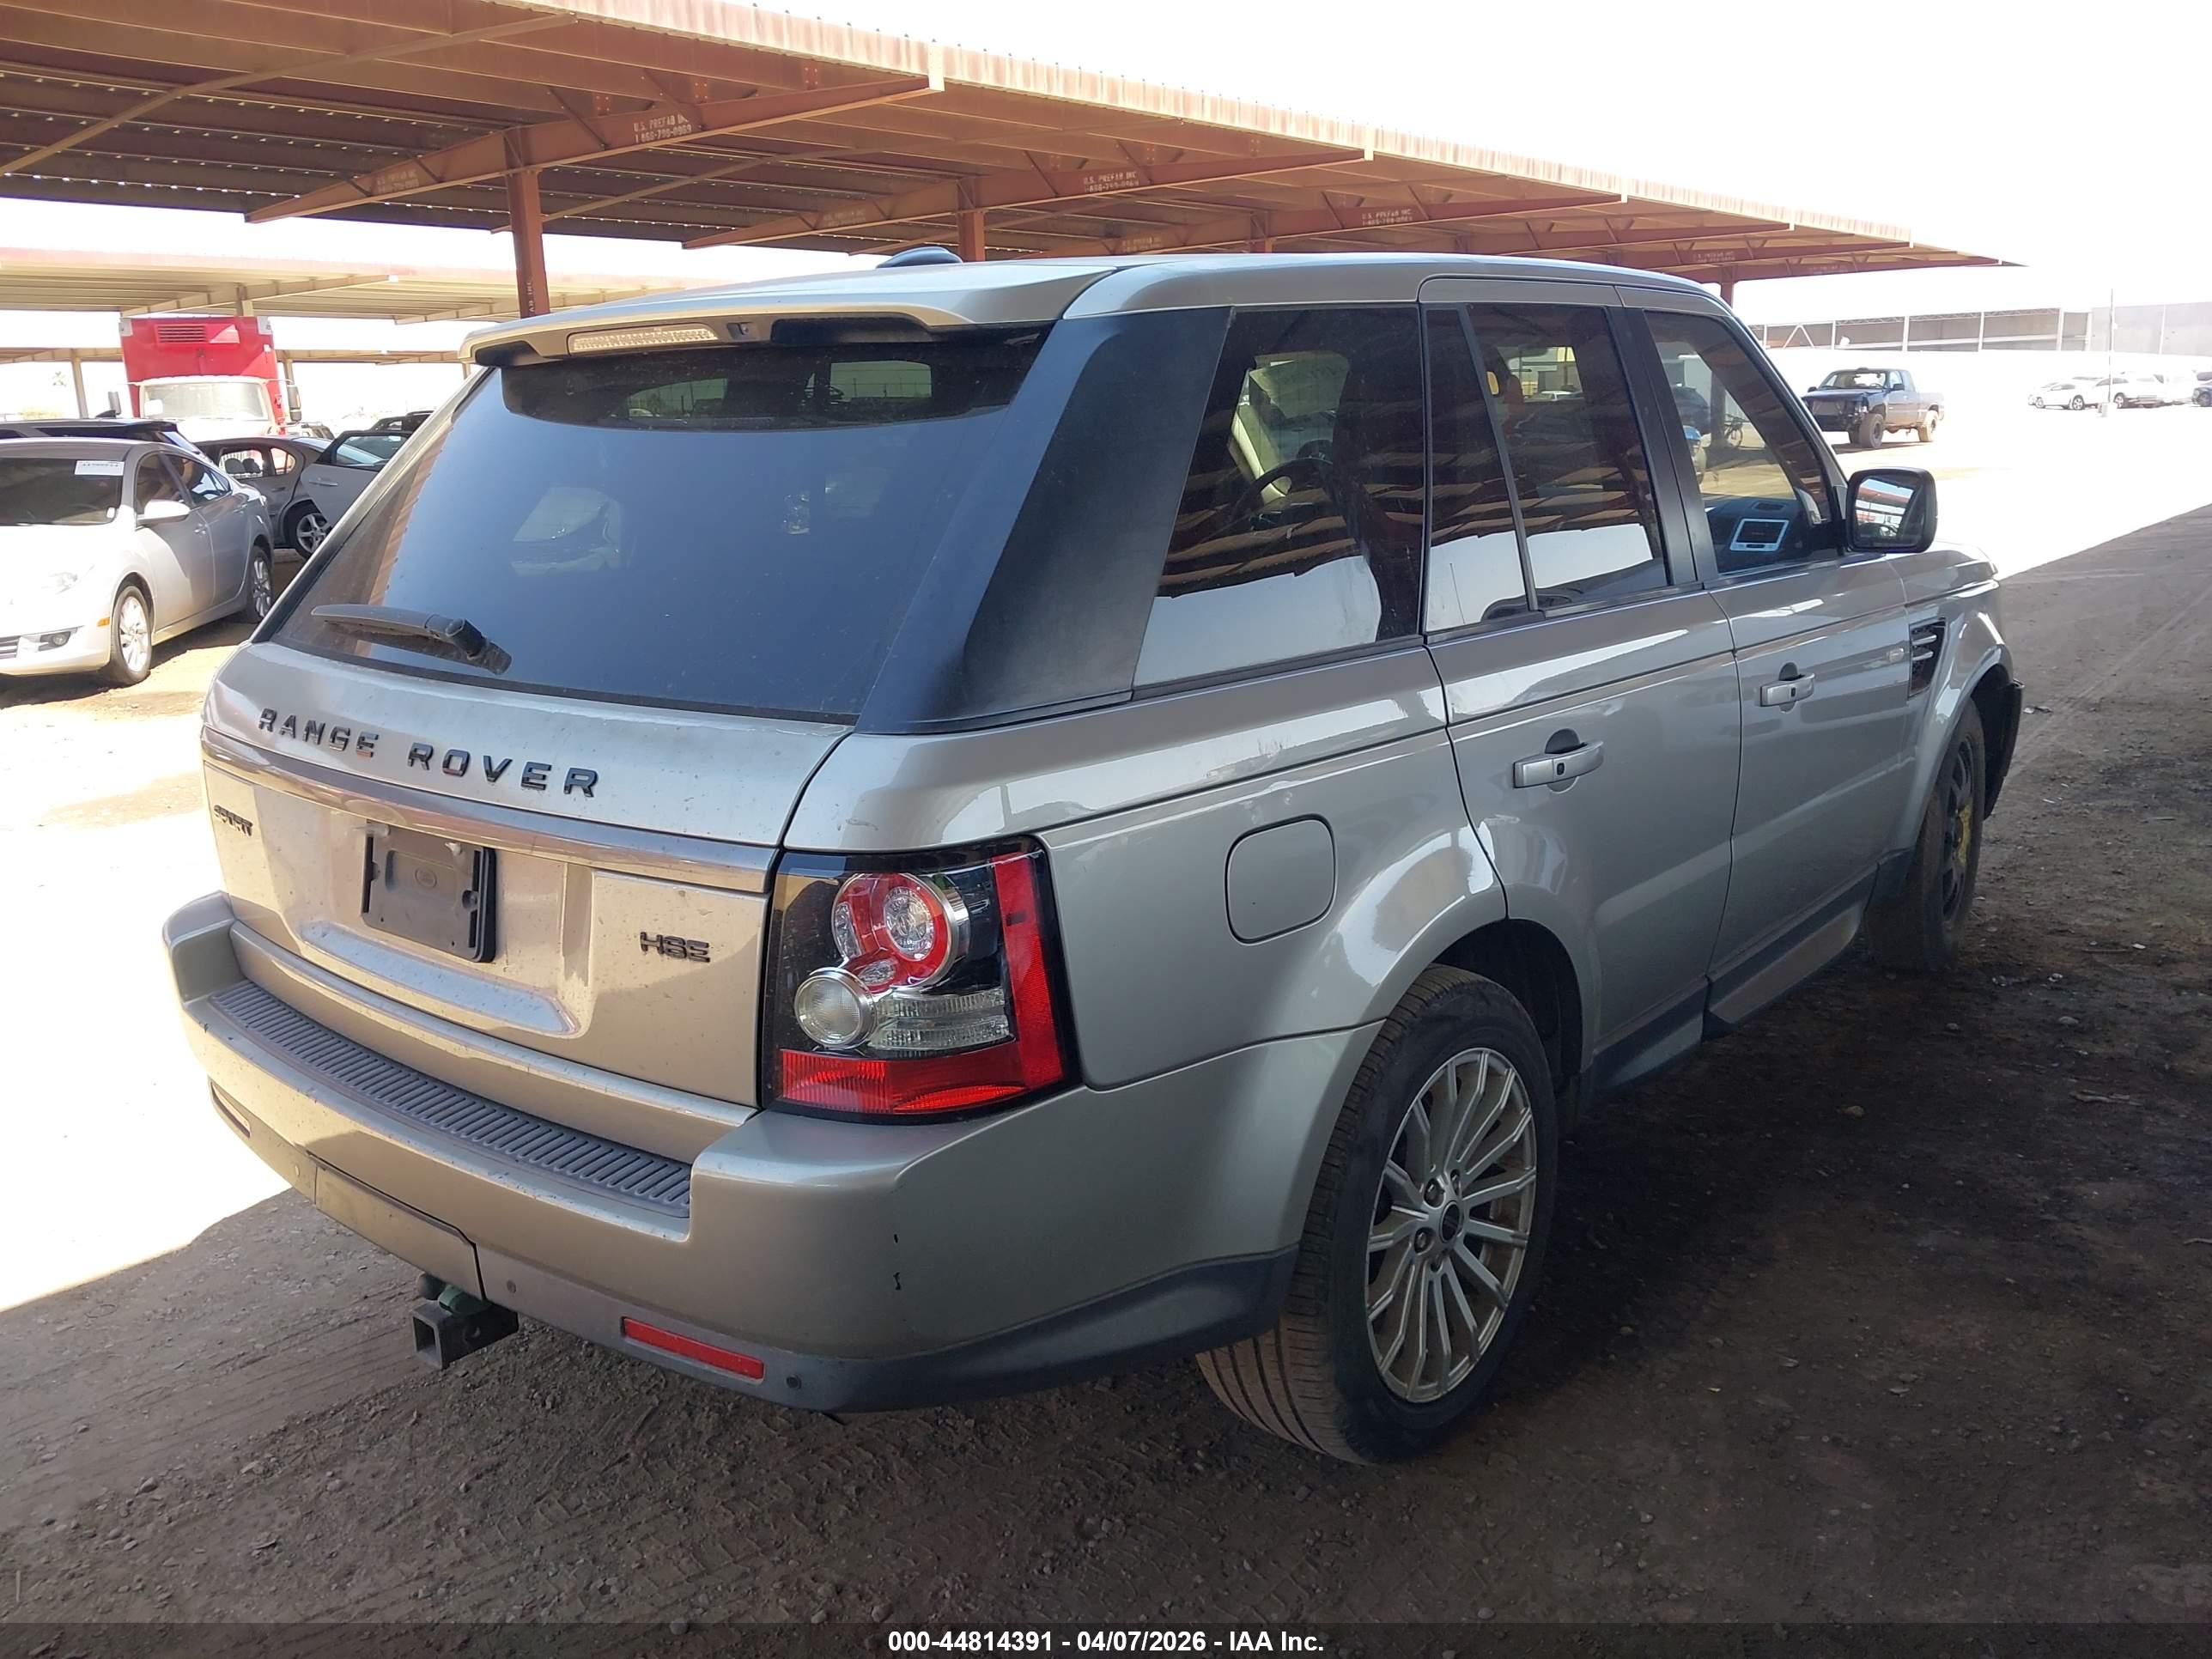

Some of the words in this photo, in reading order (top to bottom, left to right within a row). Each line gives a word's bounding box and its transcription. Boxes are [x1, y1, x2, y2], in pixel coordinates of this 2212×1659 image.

[258, 708, 380, 758] RANGE
[407, 742, 599, 799] ROVER
[640, 932, 711, 963] HSE
